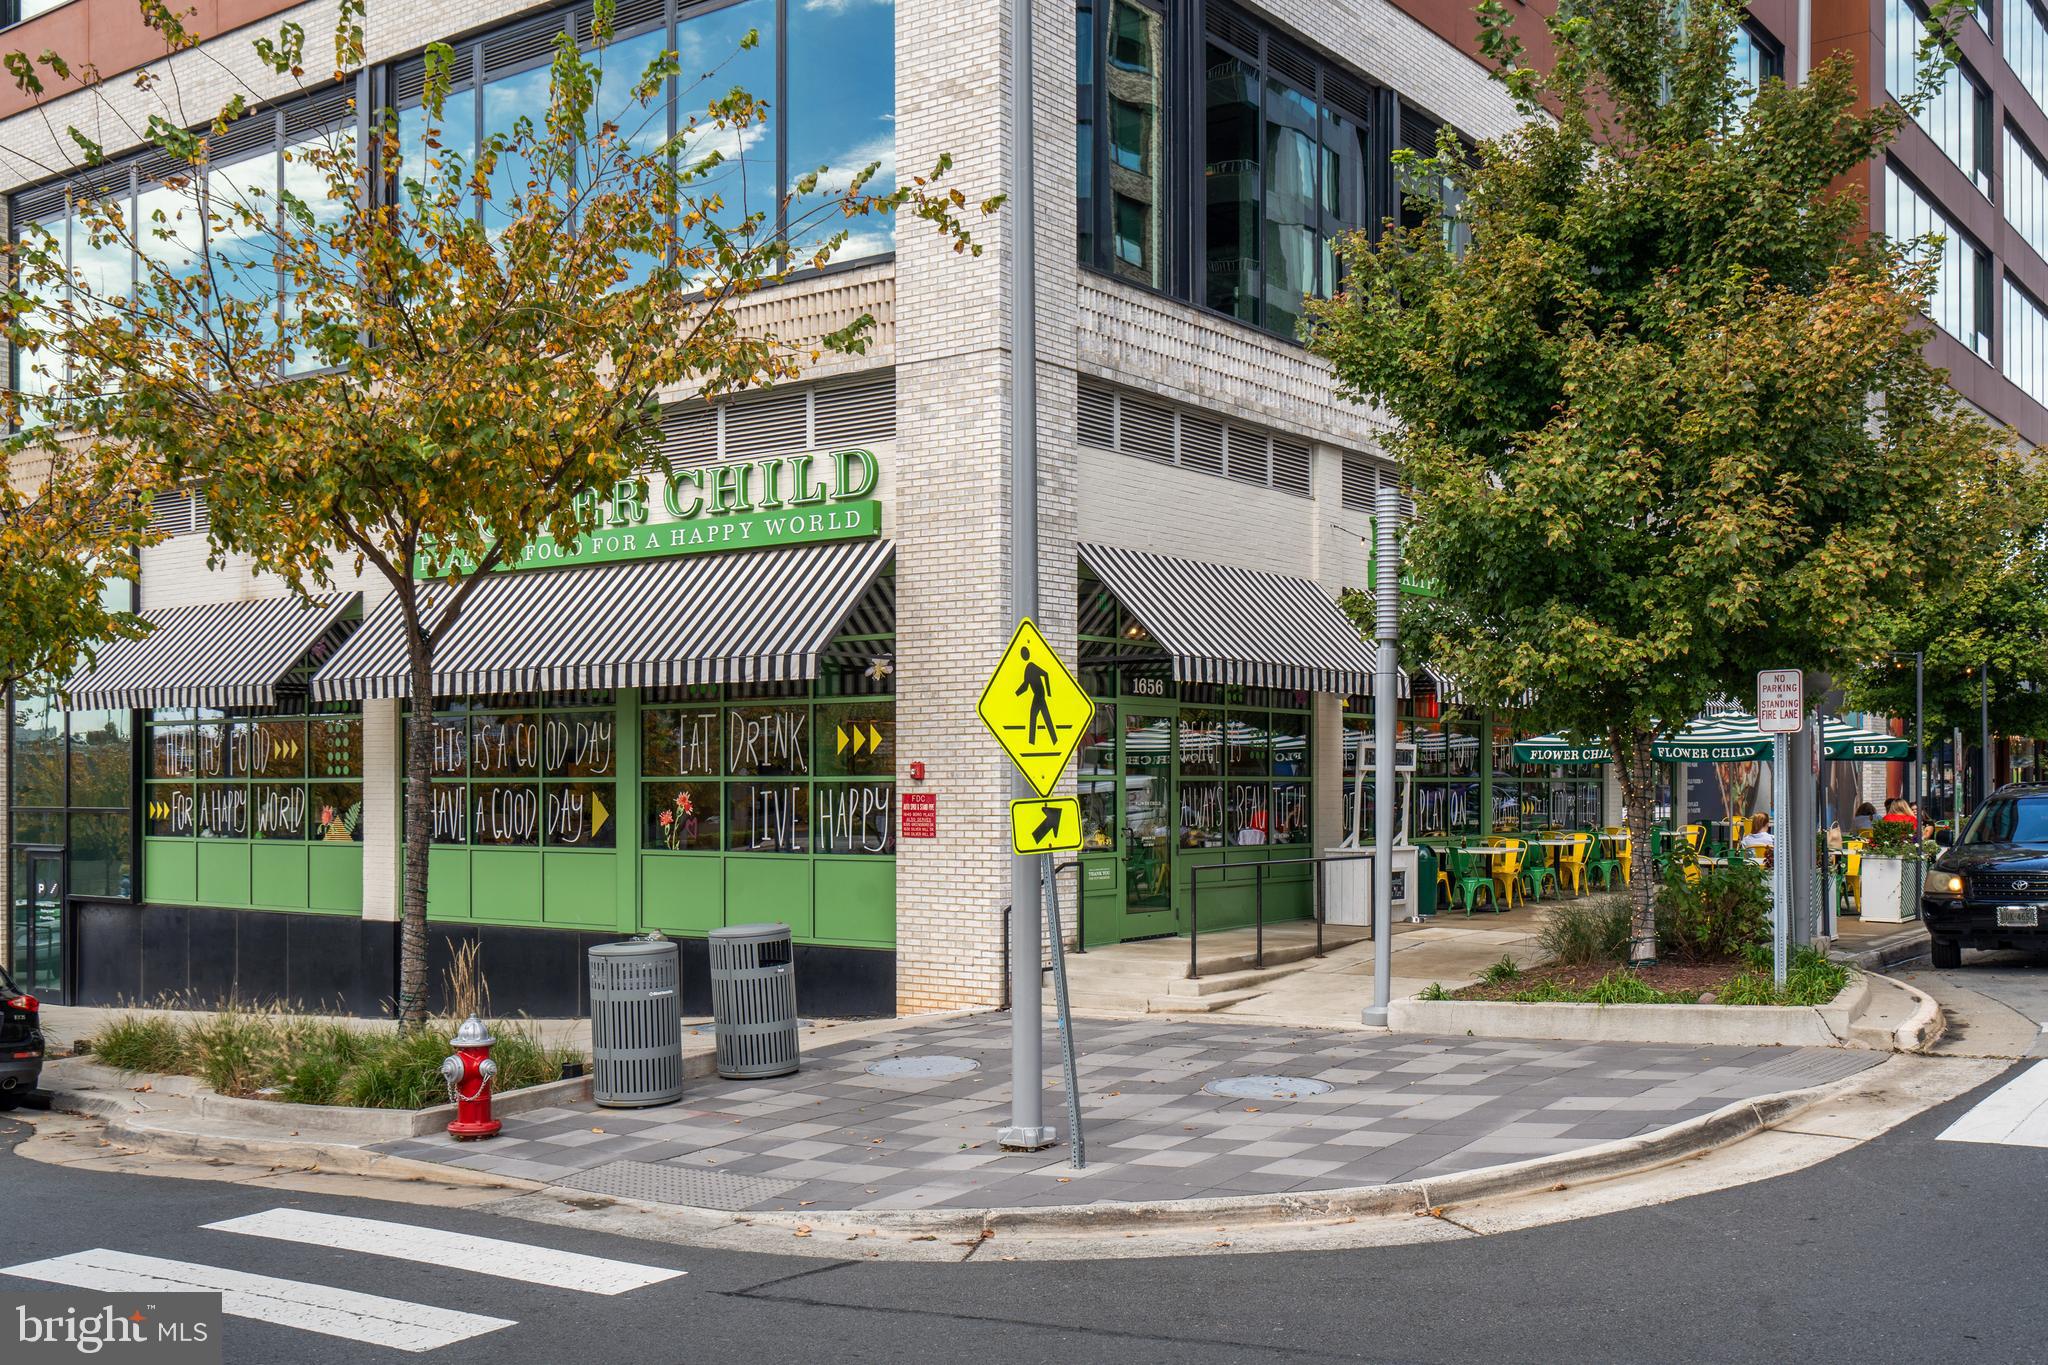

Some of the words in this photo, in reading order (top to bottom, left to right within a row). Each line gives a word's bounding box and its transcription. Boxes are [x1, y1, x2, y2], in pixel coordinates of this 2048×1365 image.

[663, 448, 879, 519] CHILD
[592, 535, 637, 555] FOR
[646, 532, 661, 549] A
[670, 521, 753, 545] HAPPY
[764, 510, 862, 535] WORLD
[1133, 678, 1164, 696] 1656
[1762, 684, 1797, 692] PARKING
[1774, 674, 1785, 682] NO
[1762, 700, 1798, 709] STANDING
[1762, 711, 1776, 720] FIRE
[1780, 710, 1798, 719] LANE
[230, 727, 270, 776] FOOD
[432, 722, 463, 772] HIS
[474, 724, 490, 772] IS
[498, 724, 508, 768] A
[516, 721, 569, 772] GOOD
[575, 721, 612, 774] DAY
[680, 714, 716, 775] EAT,
[730, 711, 808, 774] DRINK,
[1530, 750, 1580, 760] FLOWER
[1582, 749, 1612, 760] CHIL
[1658, 747, 1709, 758] FLOWER
[1712, 746, 1756, 758] CHILD
[172, 790, 193, 832] FOR
[200, 792, 208, 826] A
[212, 788, 247, 833] HAPPY
[258, 786, 305, 833] WORLD
[476, 796, 486, 833] A
[492, 788, 536, 840] GOOD
[548, 788, 584, 843] DAY
[752, 786, 800, 850] LIVE
[820, 787, 890, 852] HAPPY
[912, 794, 926, 802] FDC
[1180, 786, 1224, 829] ALWAYS
[1420, 788, 1446, 832] PLAY
[1450, 791, 1467, 827] ON
